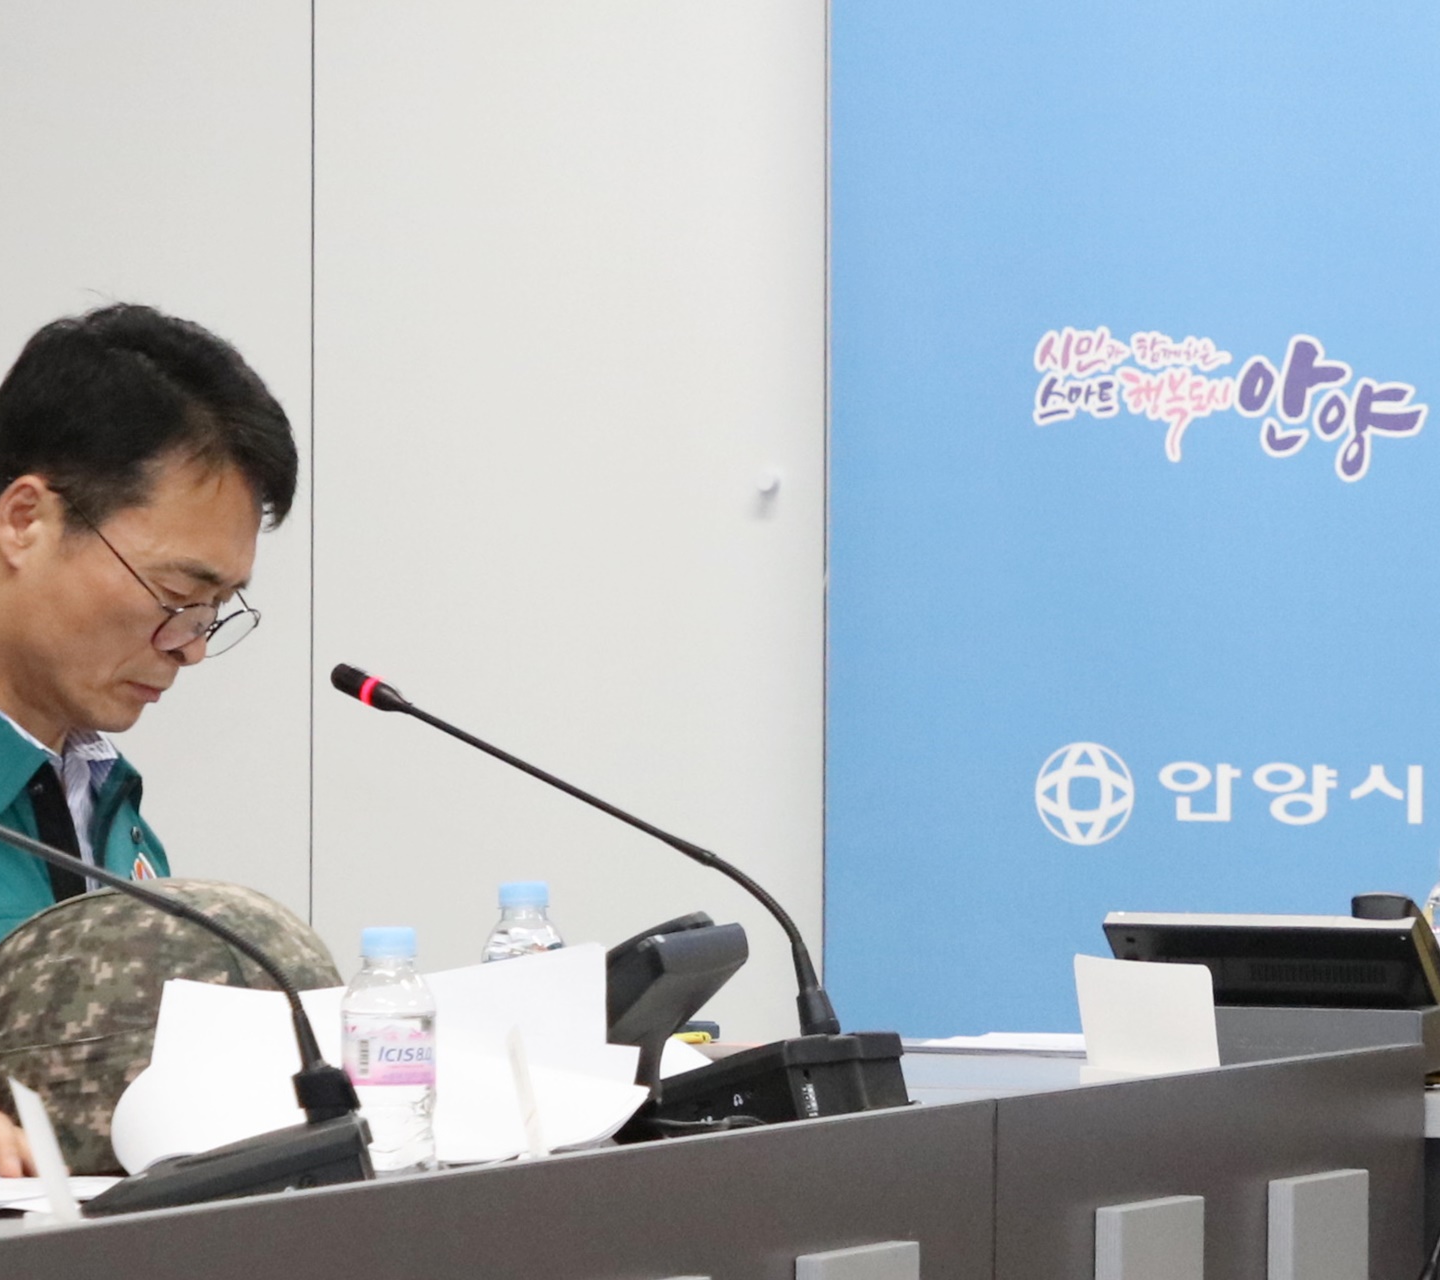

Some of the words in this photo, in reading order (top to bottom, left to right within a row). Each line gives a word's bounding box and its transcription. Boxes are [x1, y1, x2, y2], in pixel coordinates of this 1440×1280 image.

[1036, 330, 1127, 373] 시민과
[1037, 375, 1116, 420] 스마트
[1119, 370, 1233, 458] 행복도시
[1237, 338, 1425, 478] 안양
[1158, 760, 1425, 826] 안양시
